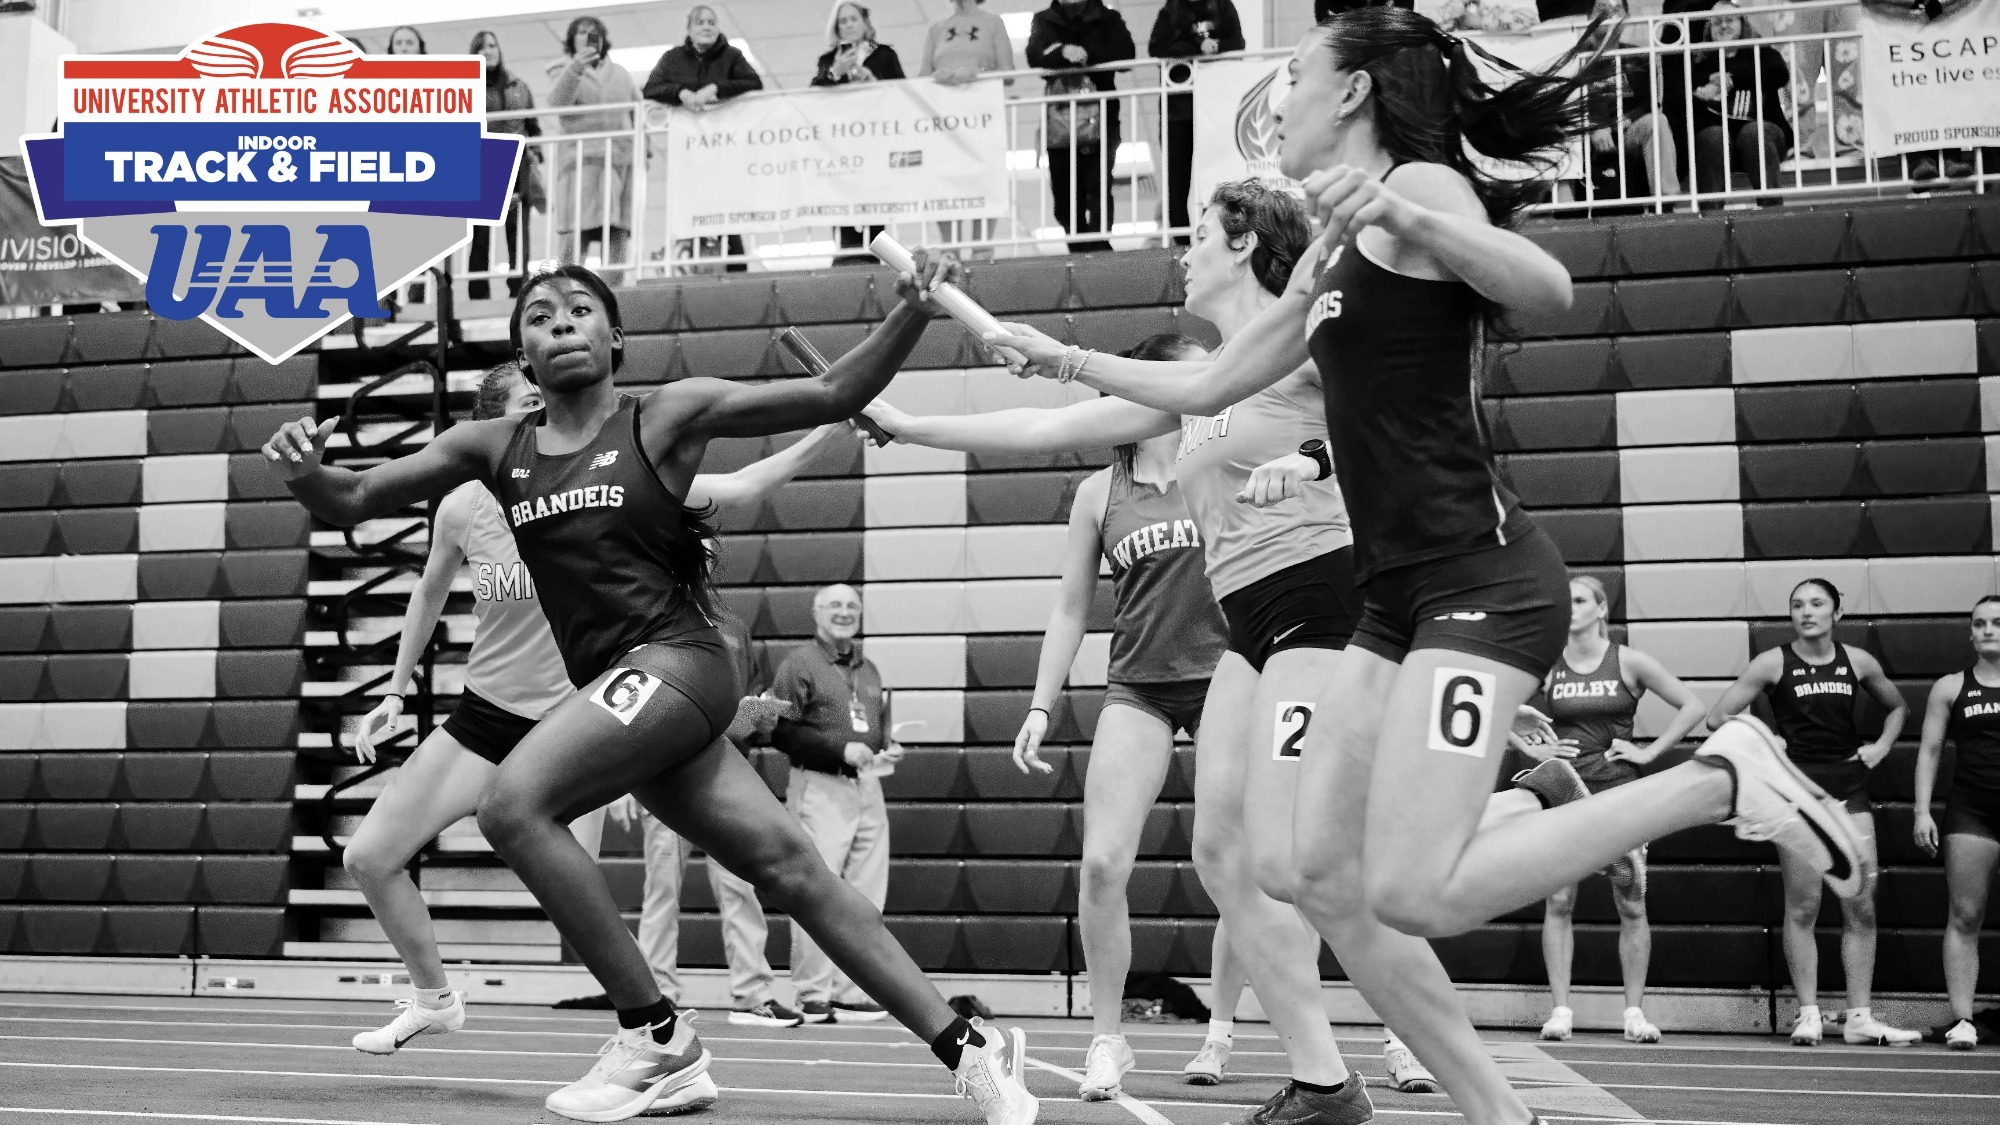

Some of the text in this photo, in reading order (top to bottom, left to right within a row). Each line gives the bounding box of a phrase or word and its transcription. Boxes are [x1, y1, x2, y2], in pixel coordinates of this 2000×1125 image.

[1889, 36, 1999, 63] ESCAP
[1892, 70, 1928, 88] the
[1936, 65, 1975, 84] live
[686, 113, 993, 151] PARK LODGE HOTEL GROUP
[1893, 128, 1939, 145] PROUD
[747, 155, 865, 177] COURTYARD
[692, 212, 726, 228] PROUD
[729, 209, 778, 226] SPONSOR
[796, 203, 850, 220] BRANDEIS
[853, 201, 919, 216] UNIVERSITY
[923, 196, 986, 213] ATHLETICS
[511, 484, 625, 527] BRANDEIS
[603, 669, 649, 713] 6
[1552, 679, 1619, 700] COLBY
[1794, 681, 1853, 698] BRANDEIS
[1440, 675, 1483, 748] 6
[1279, 705, 1313, 758] 2
